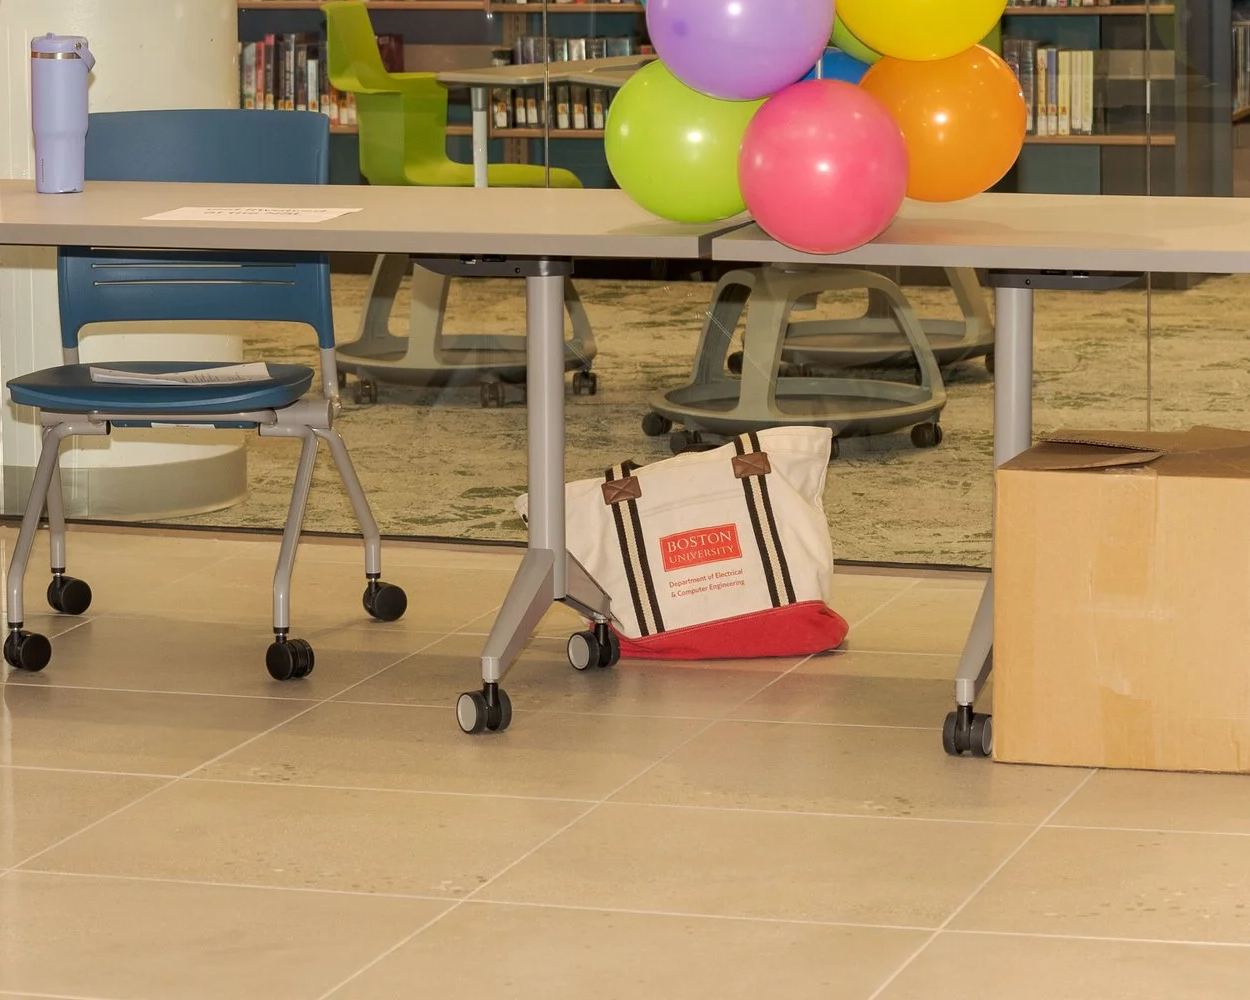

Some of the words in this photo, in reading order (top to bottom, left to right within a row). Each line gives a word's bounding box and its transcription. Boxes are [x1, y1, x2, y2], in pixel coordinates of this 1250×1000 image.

[667, 531, 732, 552] BOSTON
[669, 545, 734, 563] UNIVERSITY
[669, 576, 707, 588] Department
[708, 572, 714, 580] of
[715, 569, 743, 579] Electrical
[677, 586, 708, 597] Computer
[709, 580, 745, 590] Engineering
